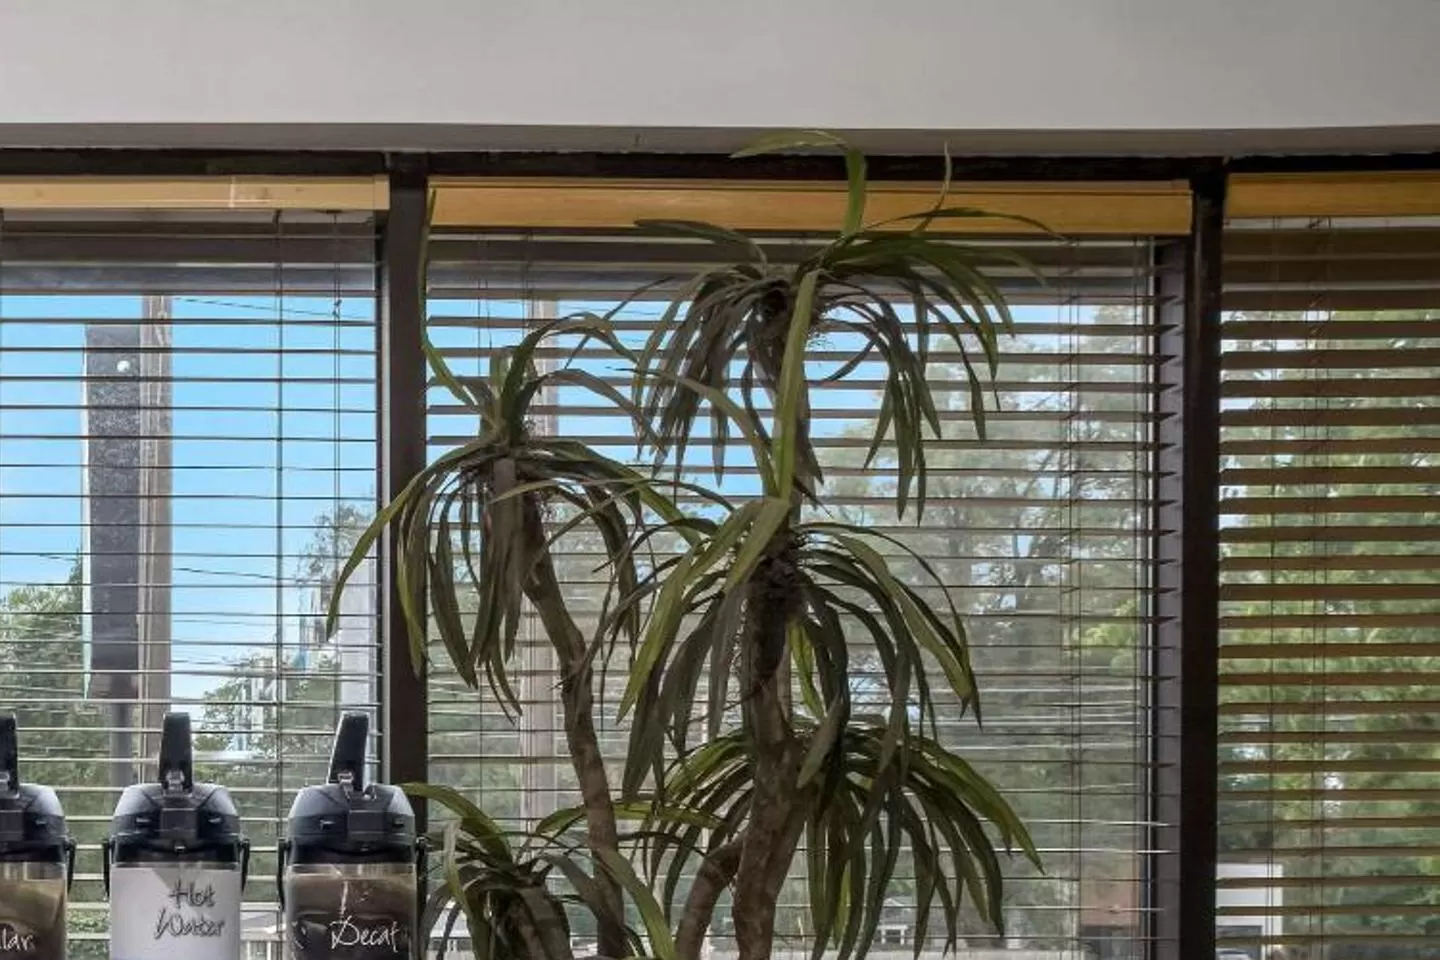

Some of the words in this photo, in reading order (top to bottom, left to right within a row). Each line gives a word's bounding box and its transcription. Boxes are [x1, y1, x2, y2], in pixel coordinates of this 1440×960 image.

[168, 879, 217, 909] Hot
[154, 907, 226, 940] Water
[329, 915, 399, 953] Decaf
